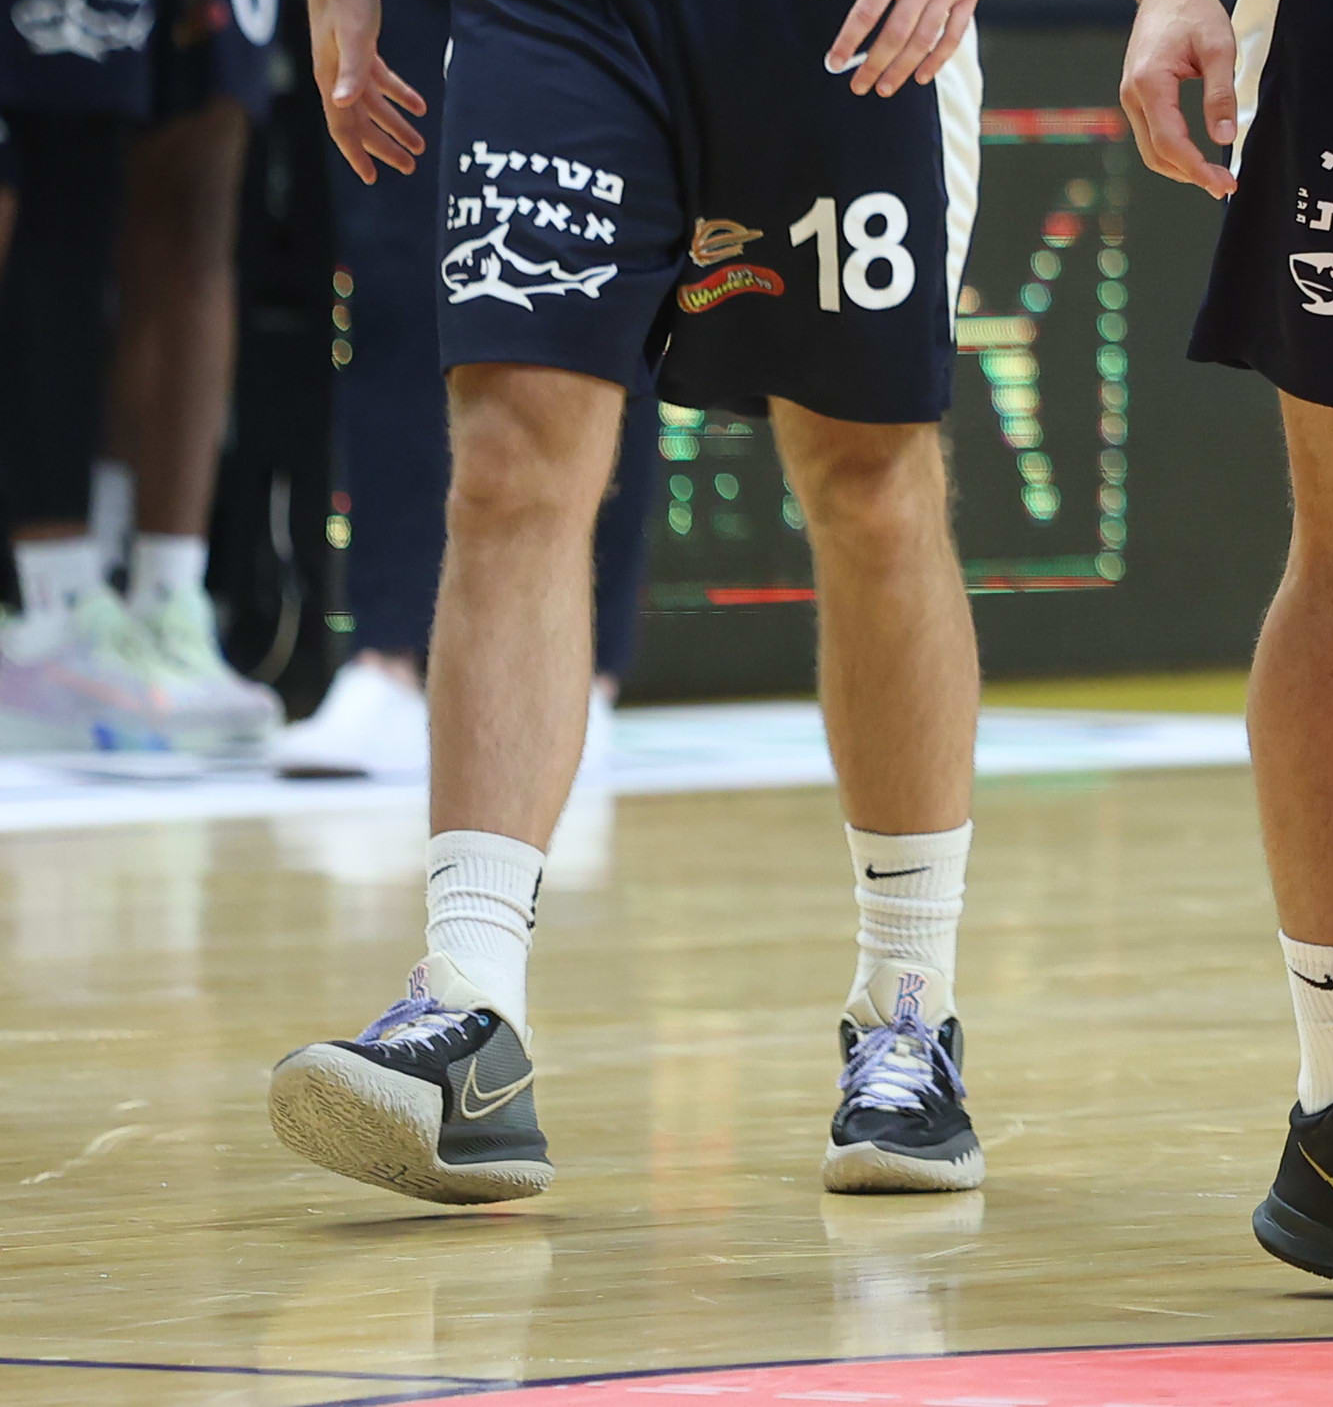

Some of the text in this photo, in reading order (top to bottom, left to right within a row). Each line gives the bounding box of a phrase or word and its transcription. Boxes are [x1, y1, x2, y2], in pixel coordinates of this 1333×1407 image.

[459, 140, 625, 205] מטיילי
[789, 192, 917, 313] 18
[690, 277, 755, 307] Winner
